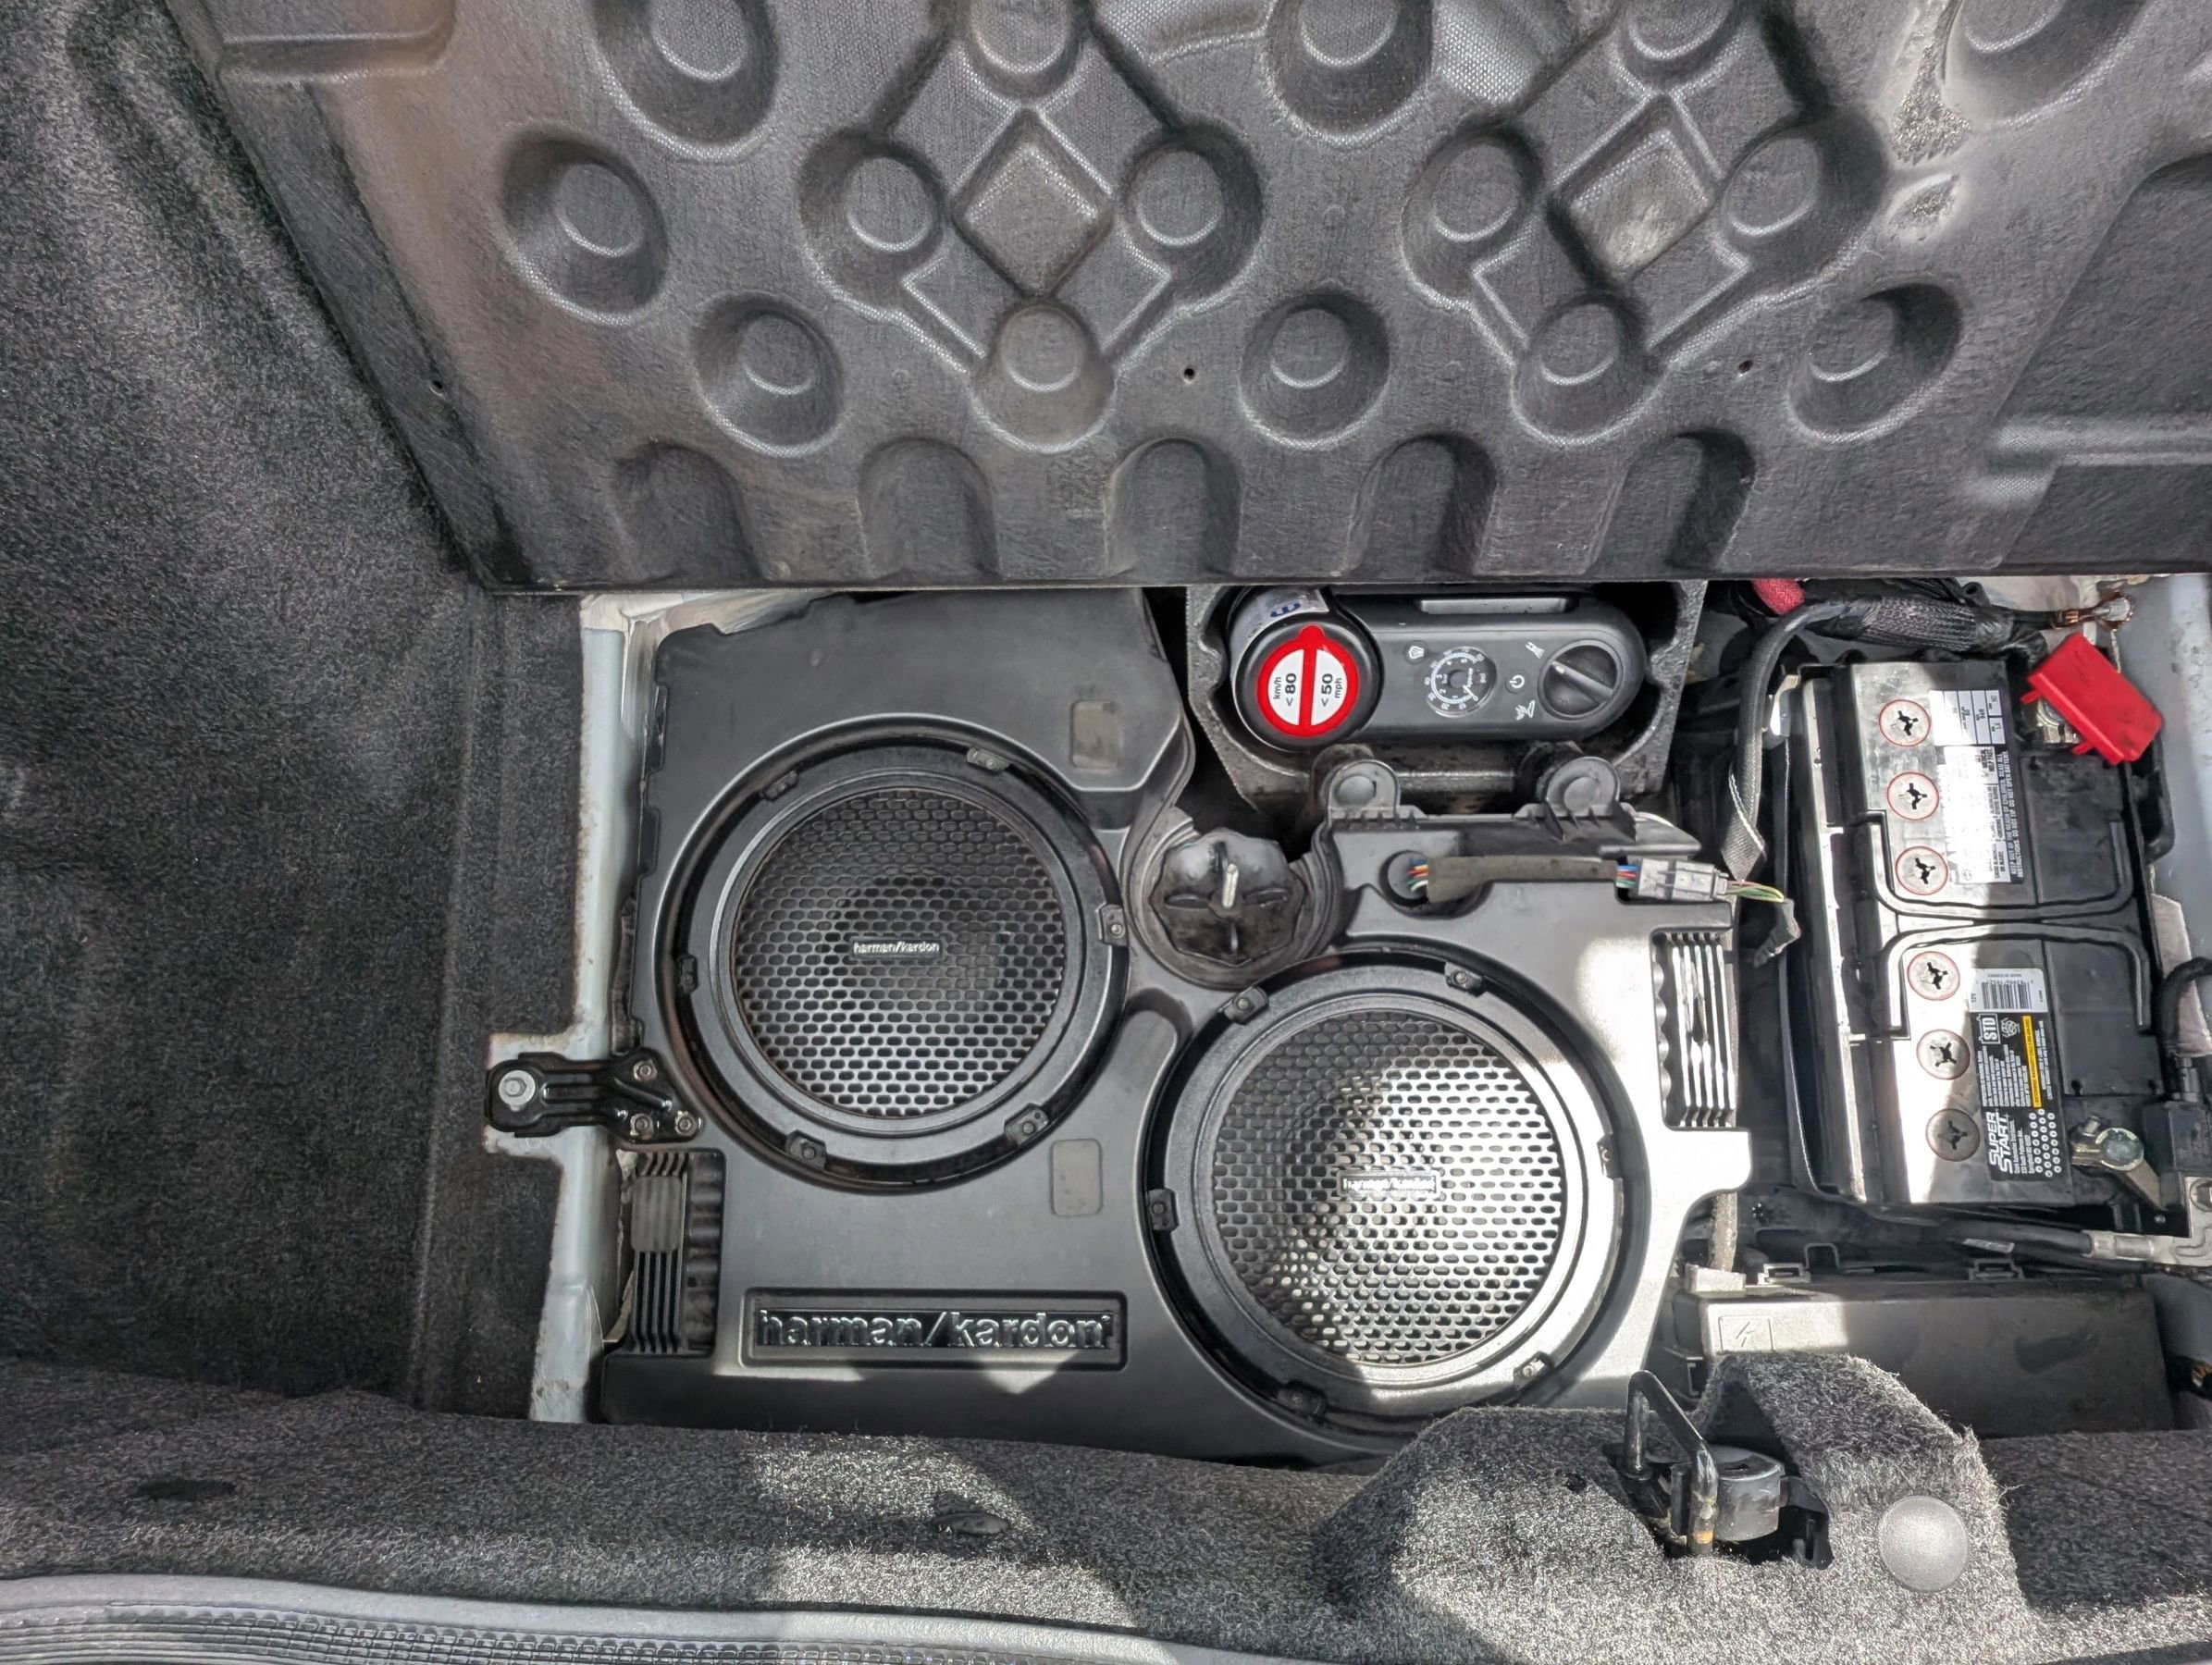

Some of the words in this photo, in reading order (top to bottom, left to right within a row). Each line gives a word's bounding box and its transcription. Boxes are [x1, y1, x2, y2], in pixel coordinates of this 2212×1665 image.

[1273, 677, 1282, 699] km/h
[1285, 673, 1296, 694] 80
[1321, 673, 1333, 695] 50
[1334, 678, 1343, 699] mph
[853, 941, 939, 954] harman/kardon
[1982, 1018, 1998, 1040] STD
[1986, 1112, 2001, 1166] SUPER
[1996, 1112, 2013, 1174] START
[759, 1309, 1106, 1348] harman/kardon
